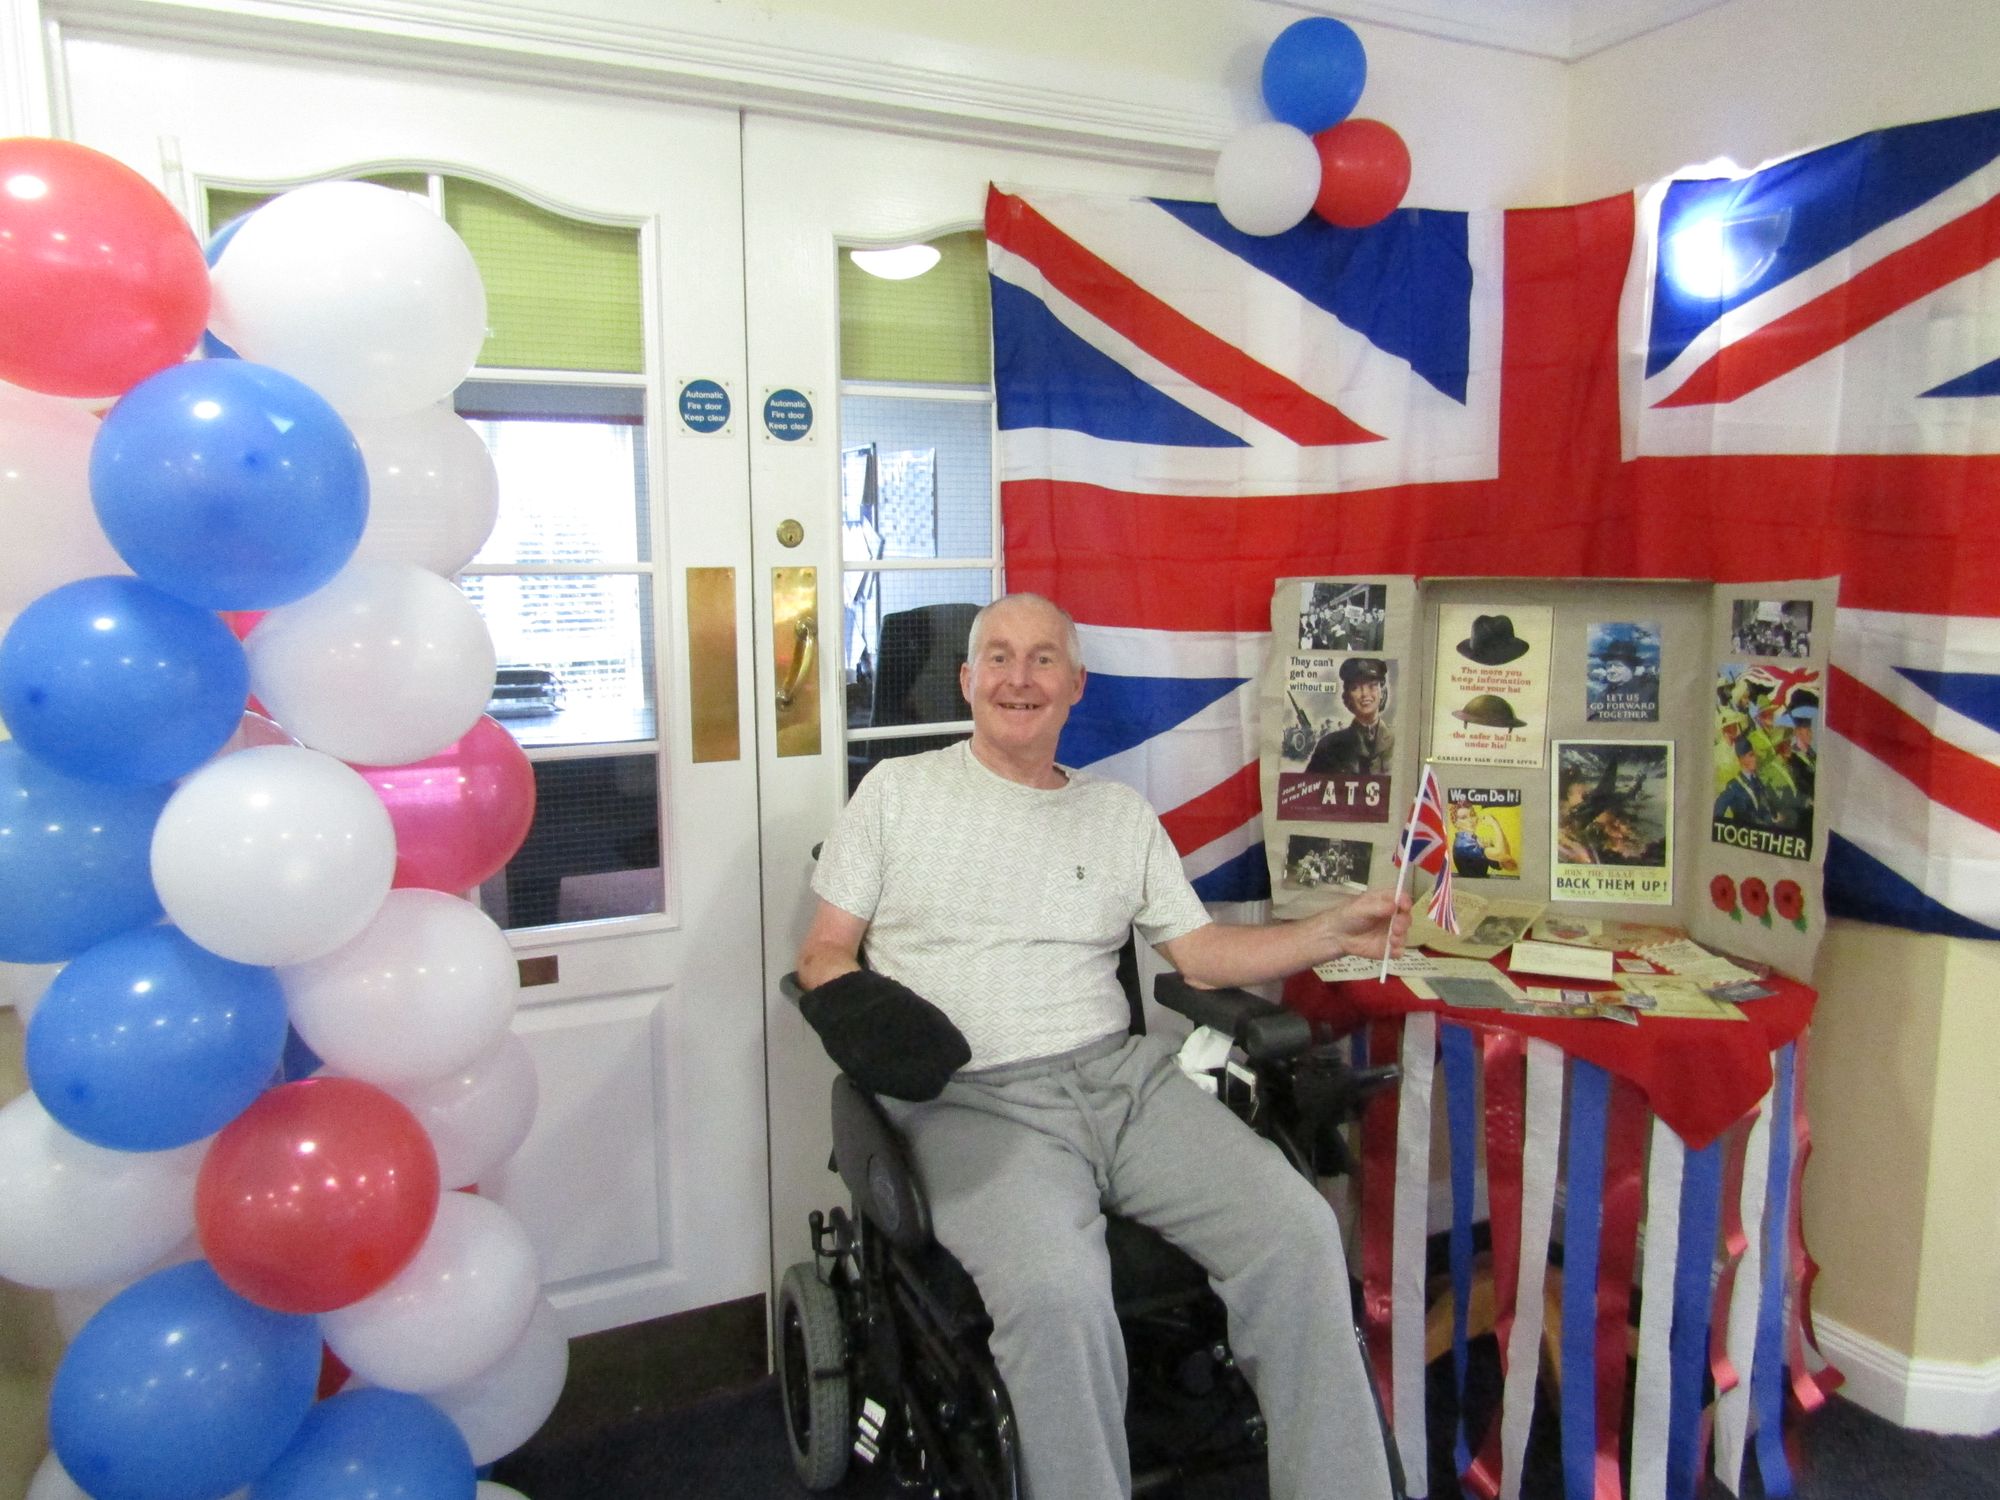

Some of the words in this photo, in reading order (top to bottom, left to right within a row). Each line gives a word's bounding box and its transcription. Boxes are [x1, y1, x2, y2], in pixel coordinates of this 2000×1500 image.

[685, 390, 724, 400] Automatic
[687, 402, 702, 410] Fire
[705, 403, 722, 411] door
[770, 399, 807, 408] Automatic
[684, 414, 705, 422] Keep
[707, 414, 726, 422] clear
[771, 410, 785, 419] Fire
[788, 411, 805, 420] door
[768, 422, 788, 431] Keep
[790, 423, 808, 431] clear
[1290, 656, 1311, 669] They
[1313, 657, 1334, 668] can't
[1290, 670, 1305, 680] get
[1307, 671, 1318, 679] on
[1461, 666, 1478, 675] The
[1505, 670, 1522, 678] you
[1451, 674, 1473, 685] keep
[1477, 676, 1531, 686] information
[1290, 682, 1322, 692] without
[1324, 684, 1335, 692] us
[1487, 686, 1506, 694] your
[1606, 693, 1623, 702] LET
[1626, 693, 1640, 702] US
[1590, 702, 1604, 710] GO
[1606, 702, 1655, 710] FORWARD
[1469, 732, 1490, 740] safer
[1464, 741, 1489, 749] under
[1301, 781, 1321, 796] NEW
[1322, 780, 1380, 807] ATS
[1450, 789, 1466, 801] We
[1467, 789, 1488, 802] Can
[1489, 789, 1505, 802] Do
[1507, 789, 1519, 802] It!
[1714, 822, 1807, 859] TOGETHER
[1556, 877, 1590, 889] BACK
[1596, 878, 1635, 891] THEM
